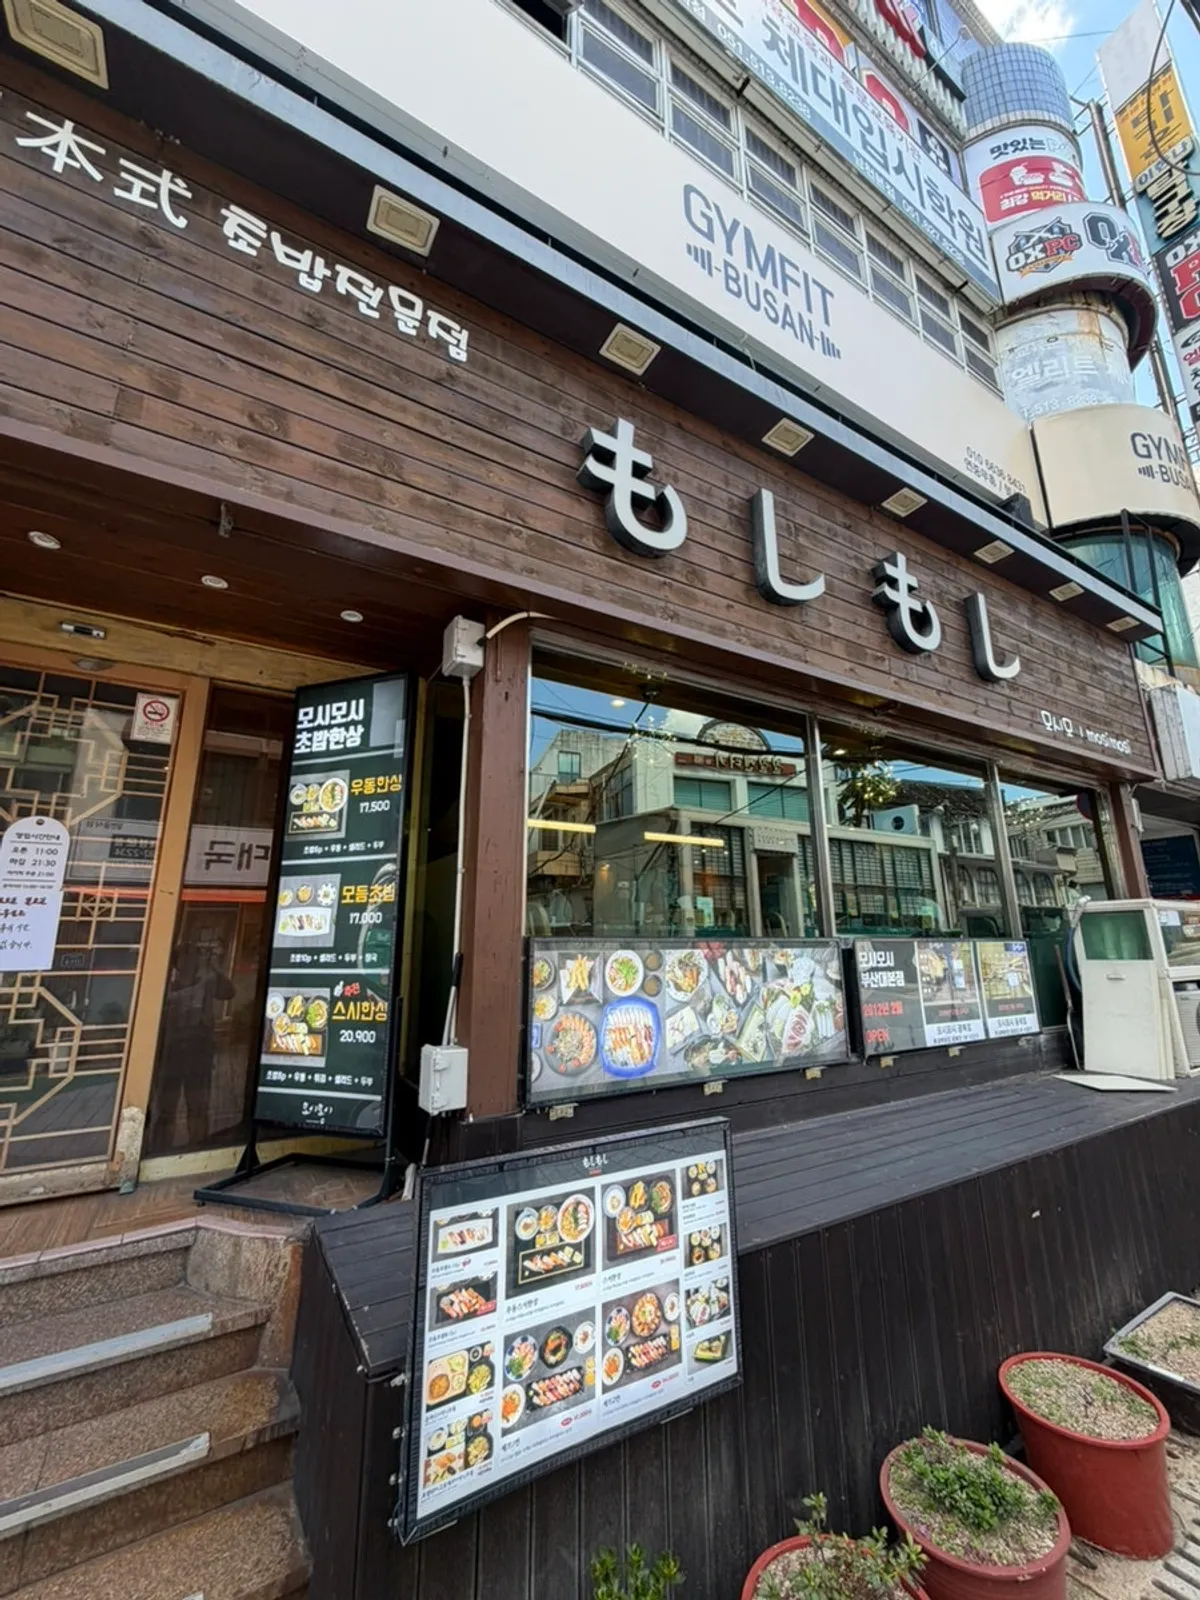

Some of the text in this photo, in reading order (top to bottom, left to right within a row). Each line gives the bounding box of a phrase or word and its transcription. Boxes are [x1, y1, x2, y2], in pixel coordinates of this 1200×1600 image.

[989, 136, 1046, 160] 맛있는
[683, 184, 835, 328] GYMFIT
[220, 204, 469, 363] 초밥전문점
[723, 258, 816, 351] BUSAN
[296, 698, 365, 729] 모시모시
[294, 725, 365, 754] 초밥한상
[351, 774, 402, 796] 우동한상
[36, 847, 59, 856] 11:00
[858, 950, 895, 968] 모시모시
[332, 1000, 389, 1021] 스시한상
